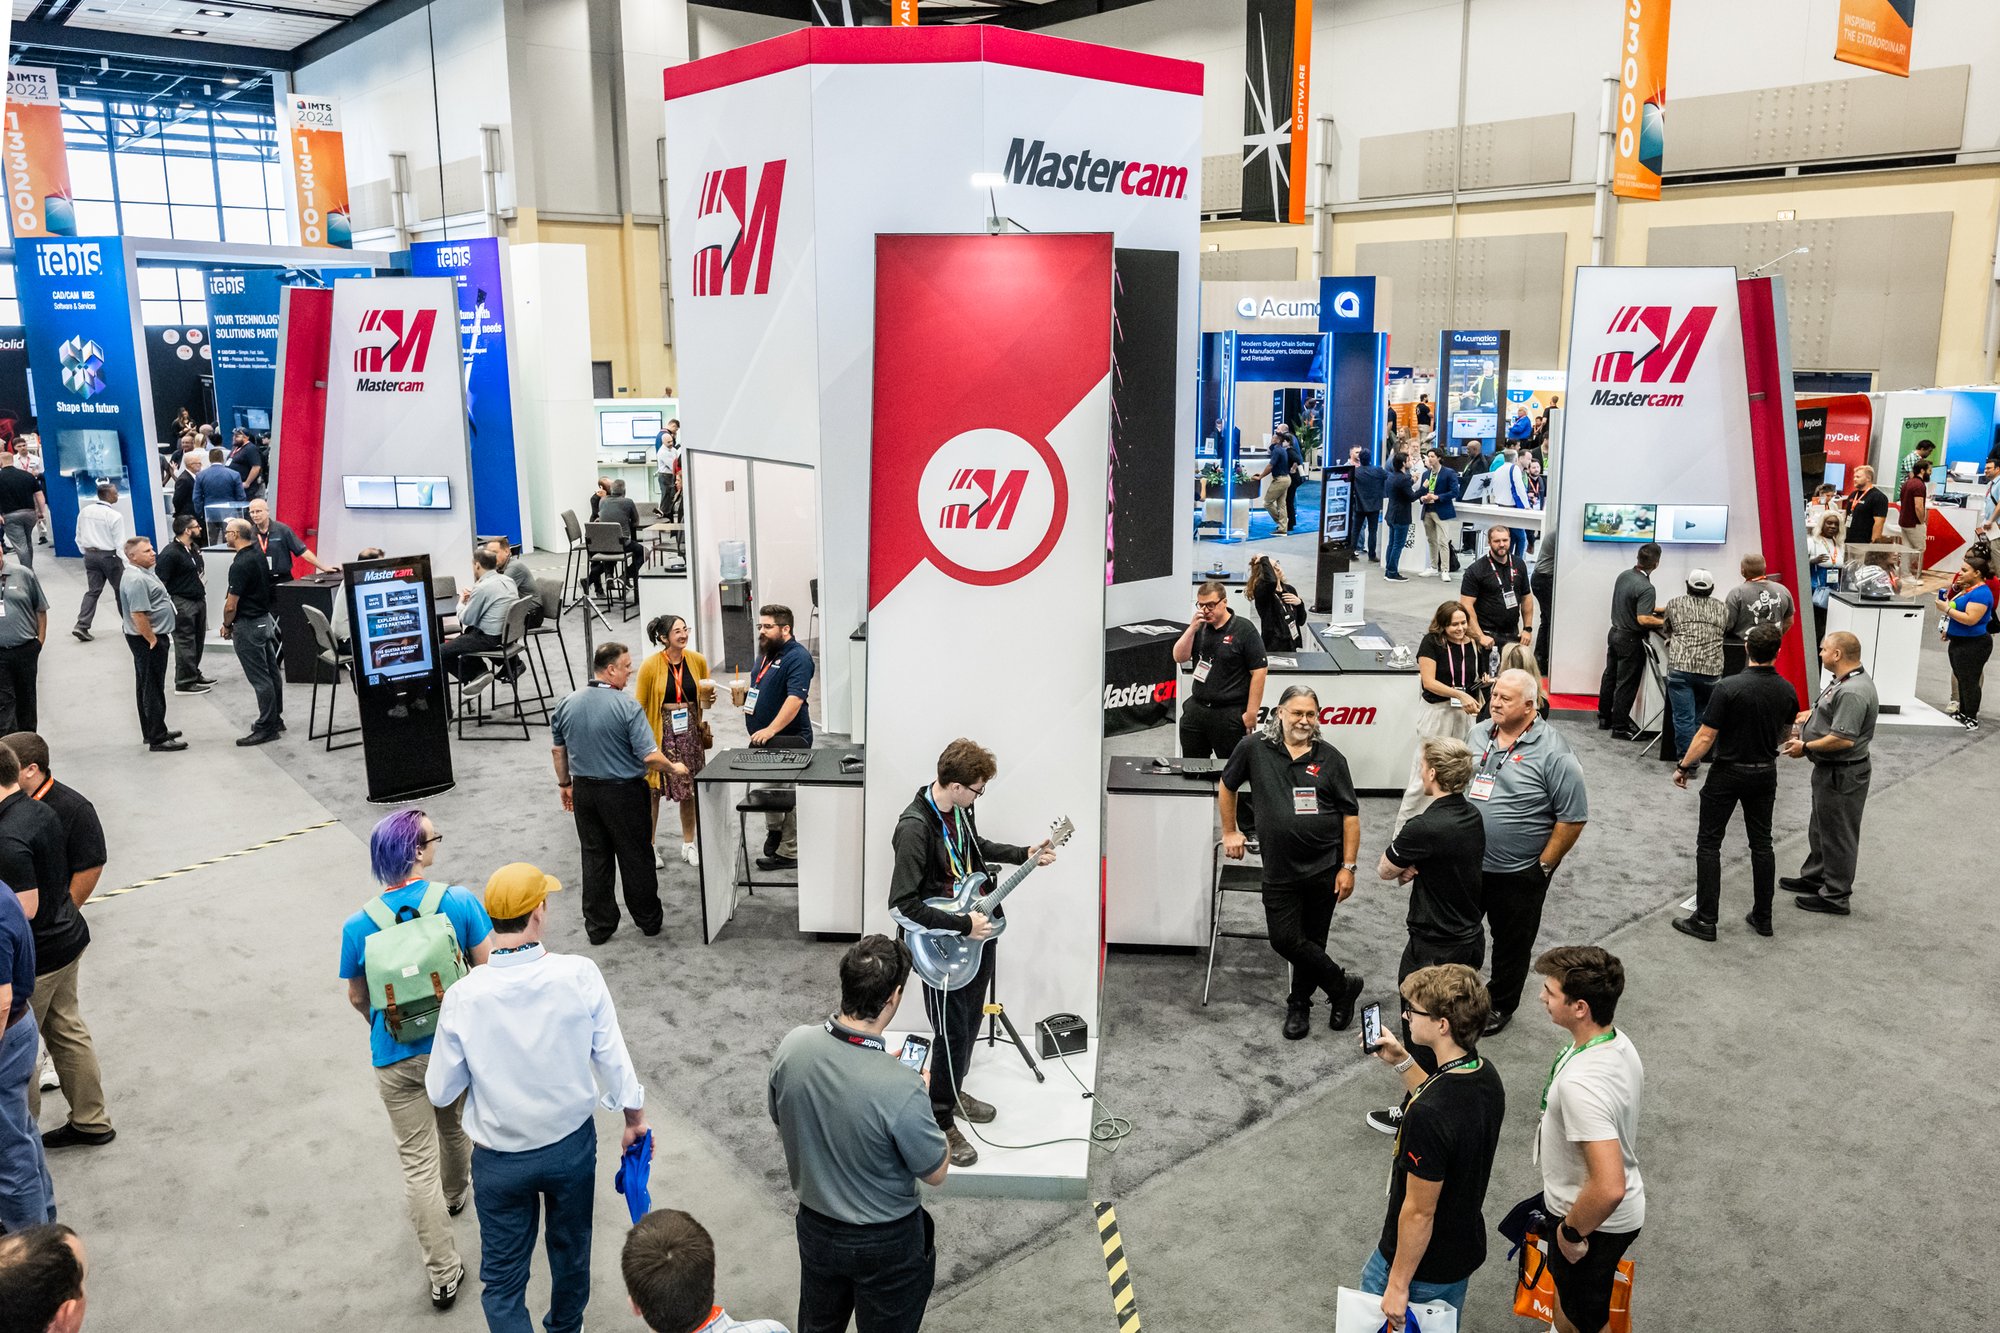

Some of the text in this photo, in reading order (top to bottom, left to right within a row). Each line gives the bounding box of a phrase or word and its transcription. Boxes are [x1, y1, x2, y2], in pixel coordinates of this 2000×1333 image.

[1844, 14, 1876, 33] INSPIRING
[1844, 28, 1907, 55] THE EXTRAORDINARY
[17, 73, 46, 83] IMTS
[7, 83, 48, 97] 2024
[1297, 64, 1306, 131] SOFTWARE
[308, 102, 332, 111] IMTS
[298, 111, 333, 123] 2024
[1003, 137, 1188, 199] Mastercam
[214, 314, 234, 325] YOUR
[215, 328, 255, 339] SOLUTIONS
[482, 323, 502, 334] needs
[1462, 334, 1498, 342] Acumatica
[1262, 341, 1281, 350] Supply
[356, 378, 425, 392] Mastercam
[1590, 389, 1685, 407] Mastercam
[56, 402, 119, 414] Shape the future
[1804, 418, 1823, 429] AnyDesk
[1825, 433, 1860, 442] nyDesk
[364, 568, 414, 582] Mastercam
